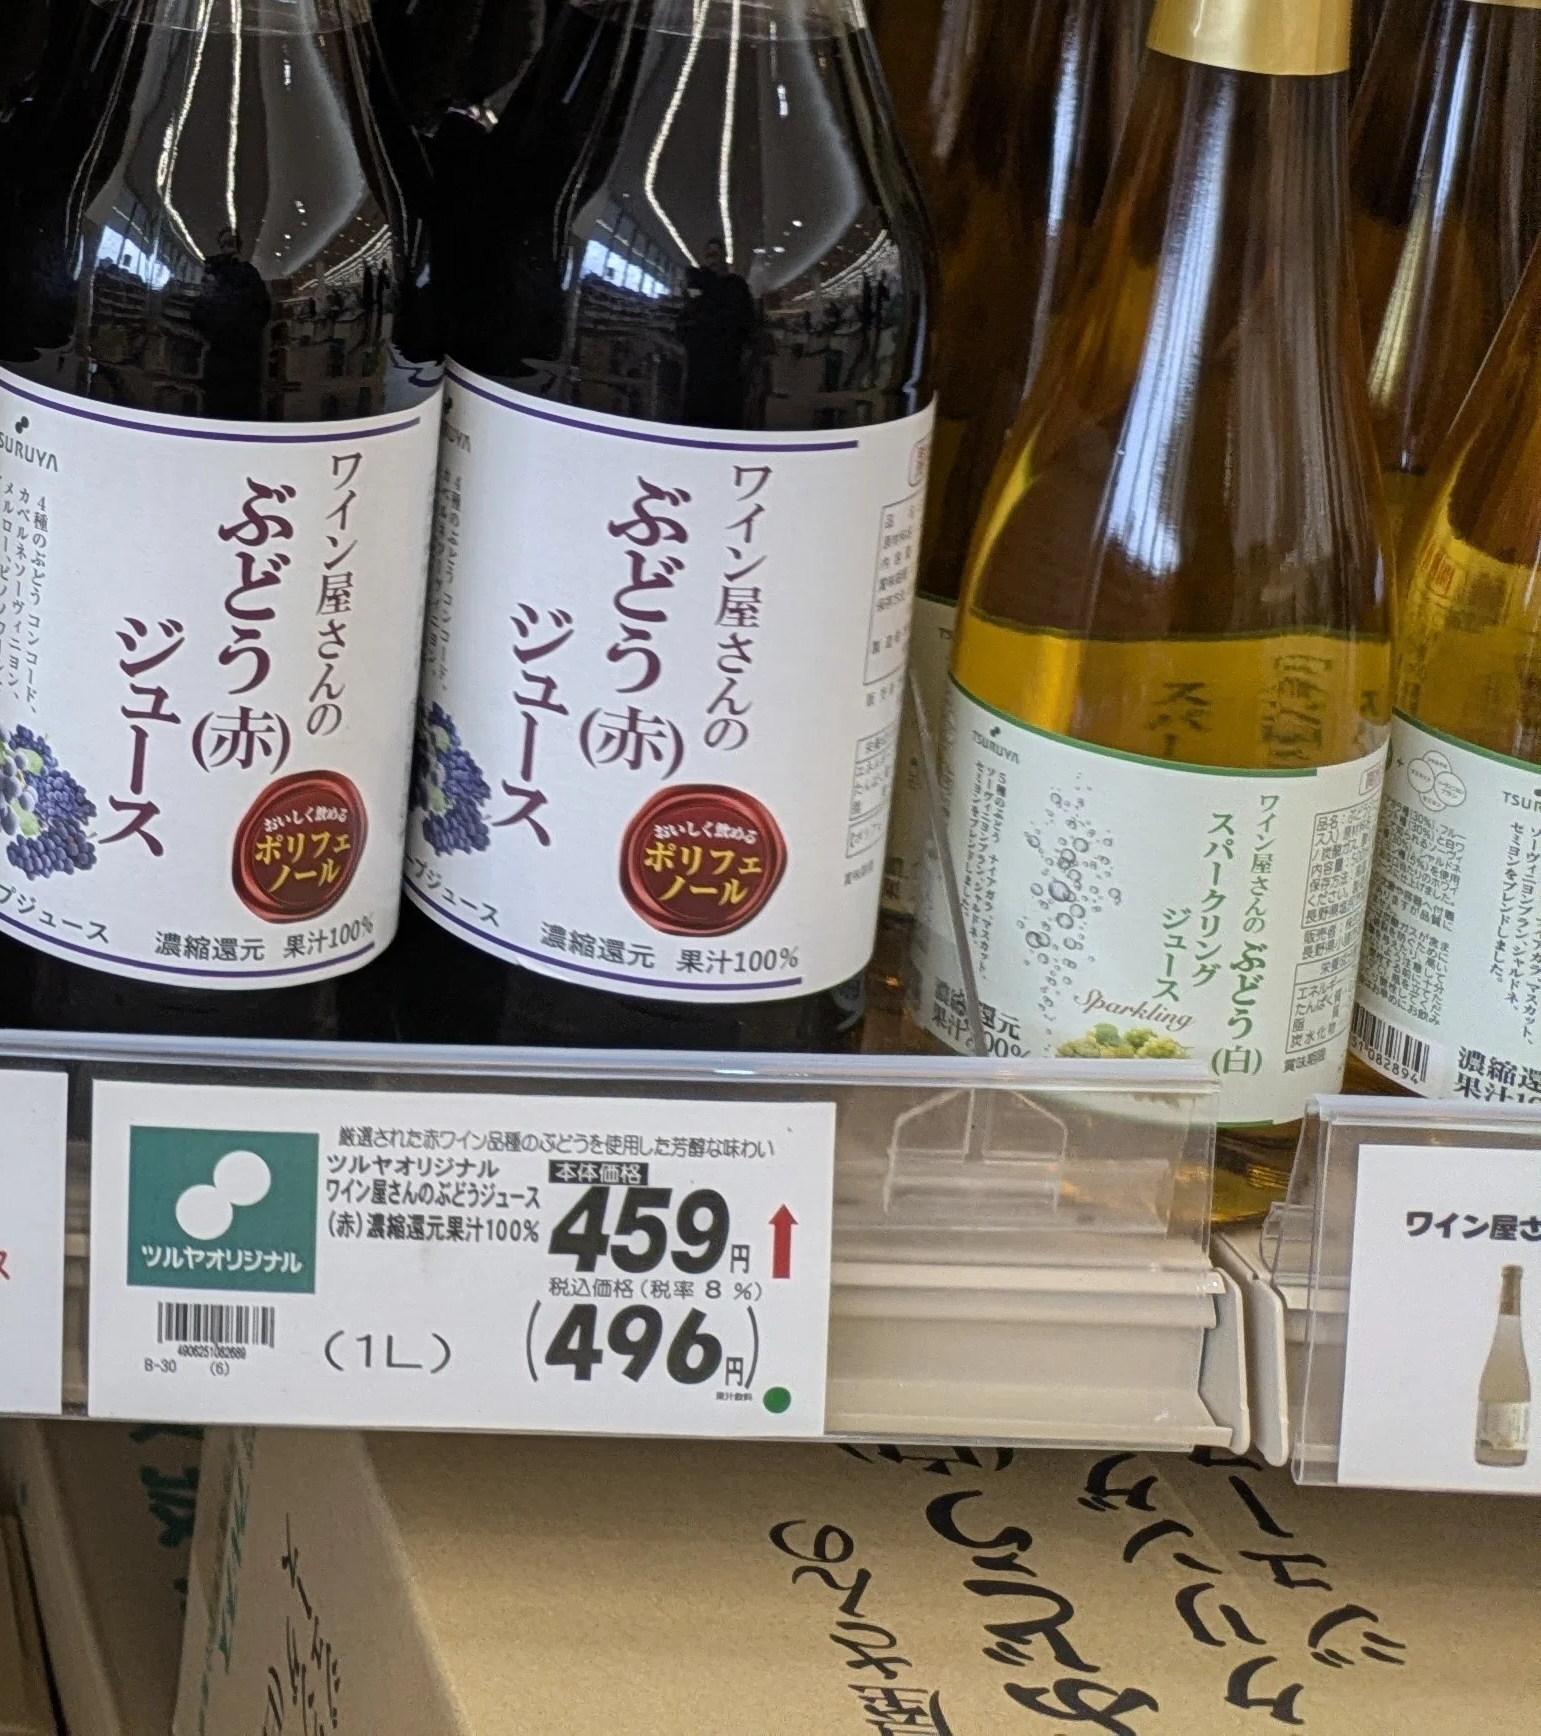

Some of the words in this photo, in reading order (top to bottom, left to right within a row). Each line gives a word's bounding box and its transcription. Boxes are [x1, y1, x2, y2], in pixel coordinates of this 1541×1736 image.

[306, 452, 364, 737] ワイン屋さんの
[97, 616, 187, 858] ジュース
[1239, 794, 1281, 935] ワイン屋さんの
[1191, 811, 1237, 989] スパークリング
[539, 921, 657, 971] 濃縮還元
[676, 946, 801, 977] 果汁100%
[1152, 907, 1191, 1004] ジュース
[1072, 987, 1196, 1033] Sparkling
[325, 1179, 541, 1211] ワイン屋さんのぶどうジュース
[327, 1154, 500, 1180] ツルヤオリジナル
[556, 1162, 643, 1185] 本体価格
[141, 1244, 303, 1275] ツルヤオリジナル
